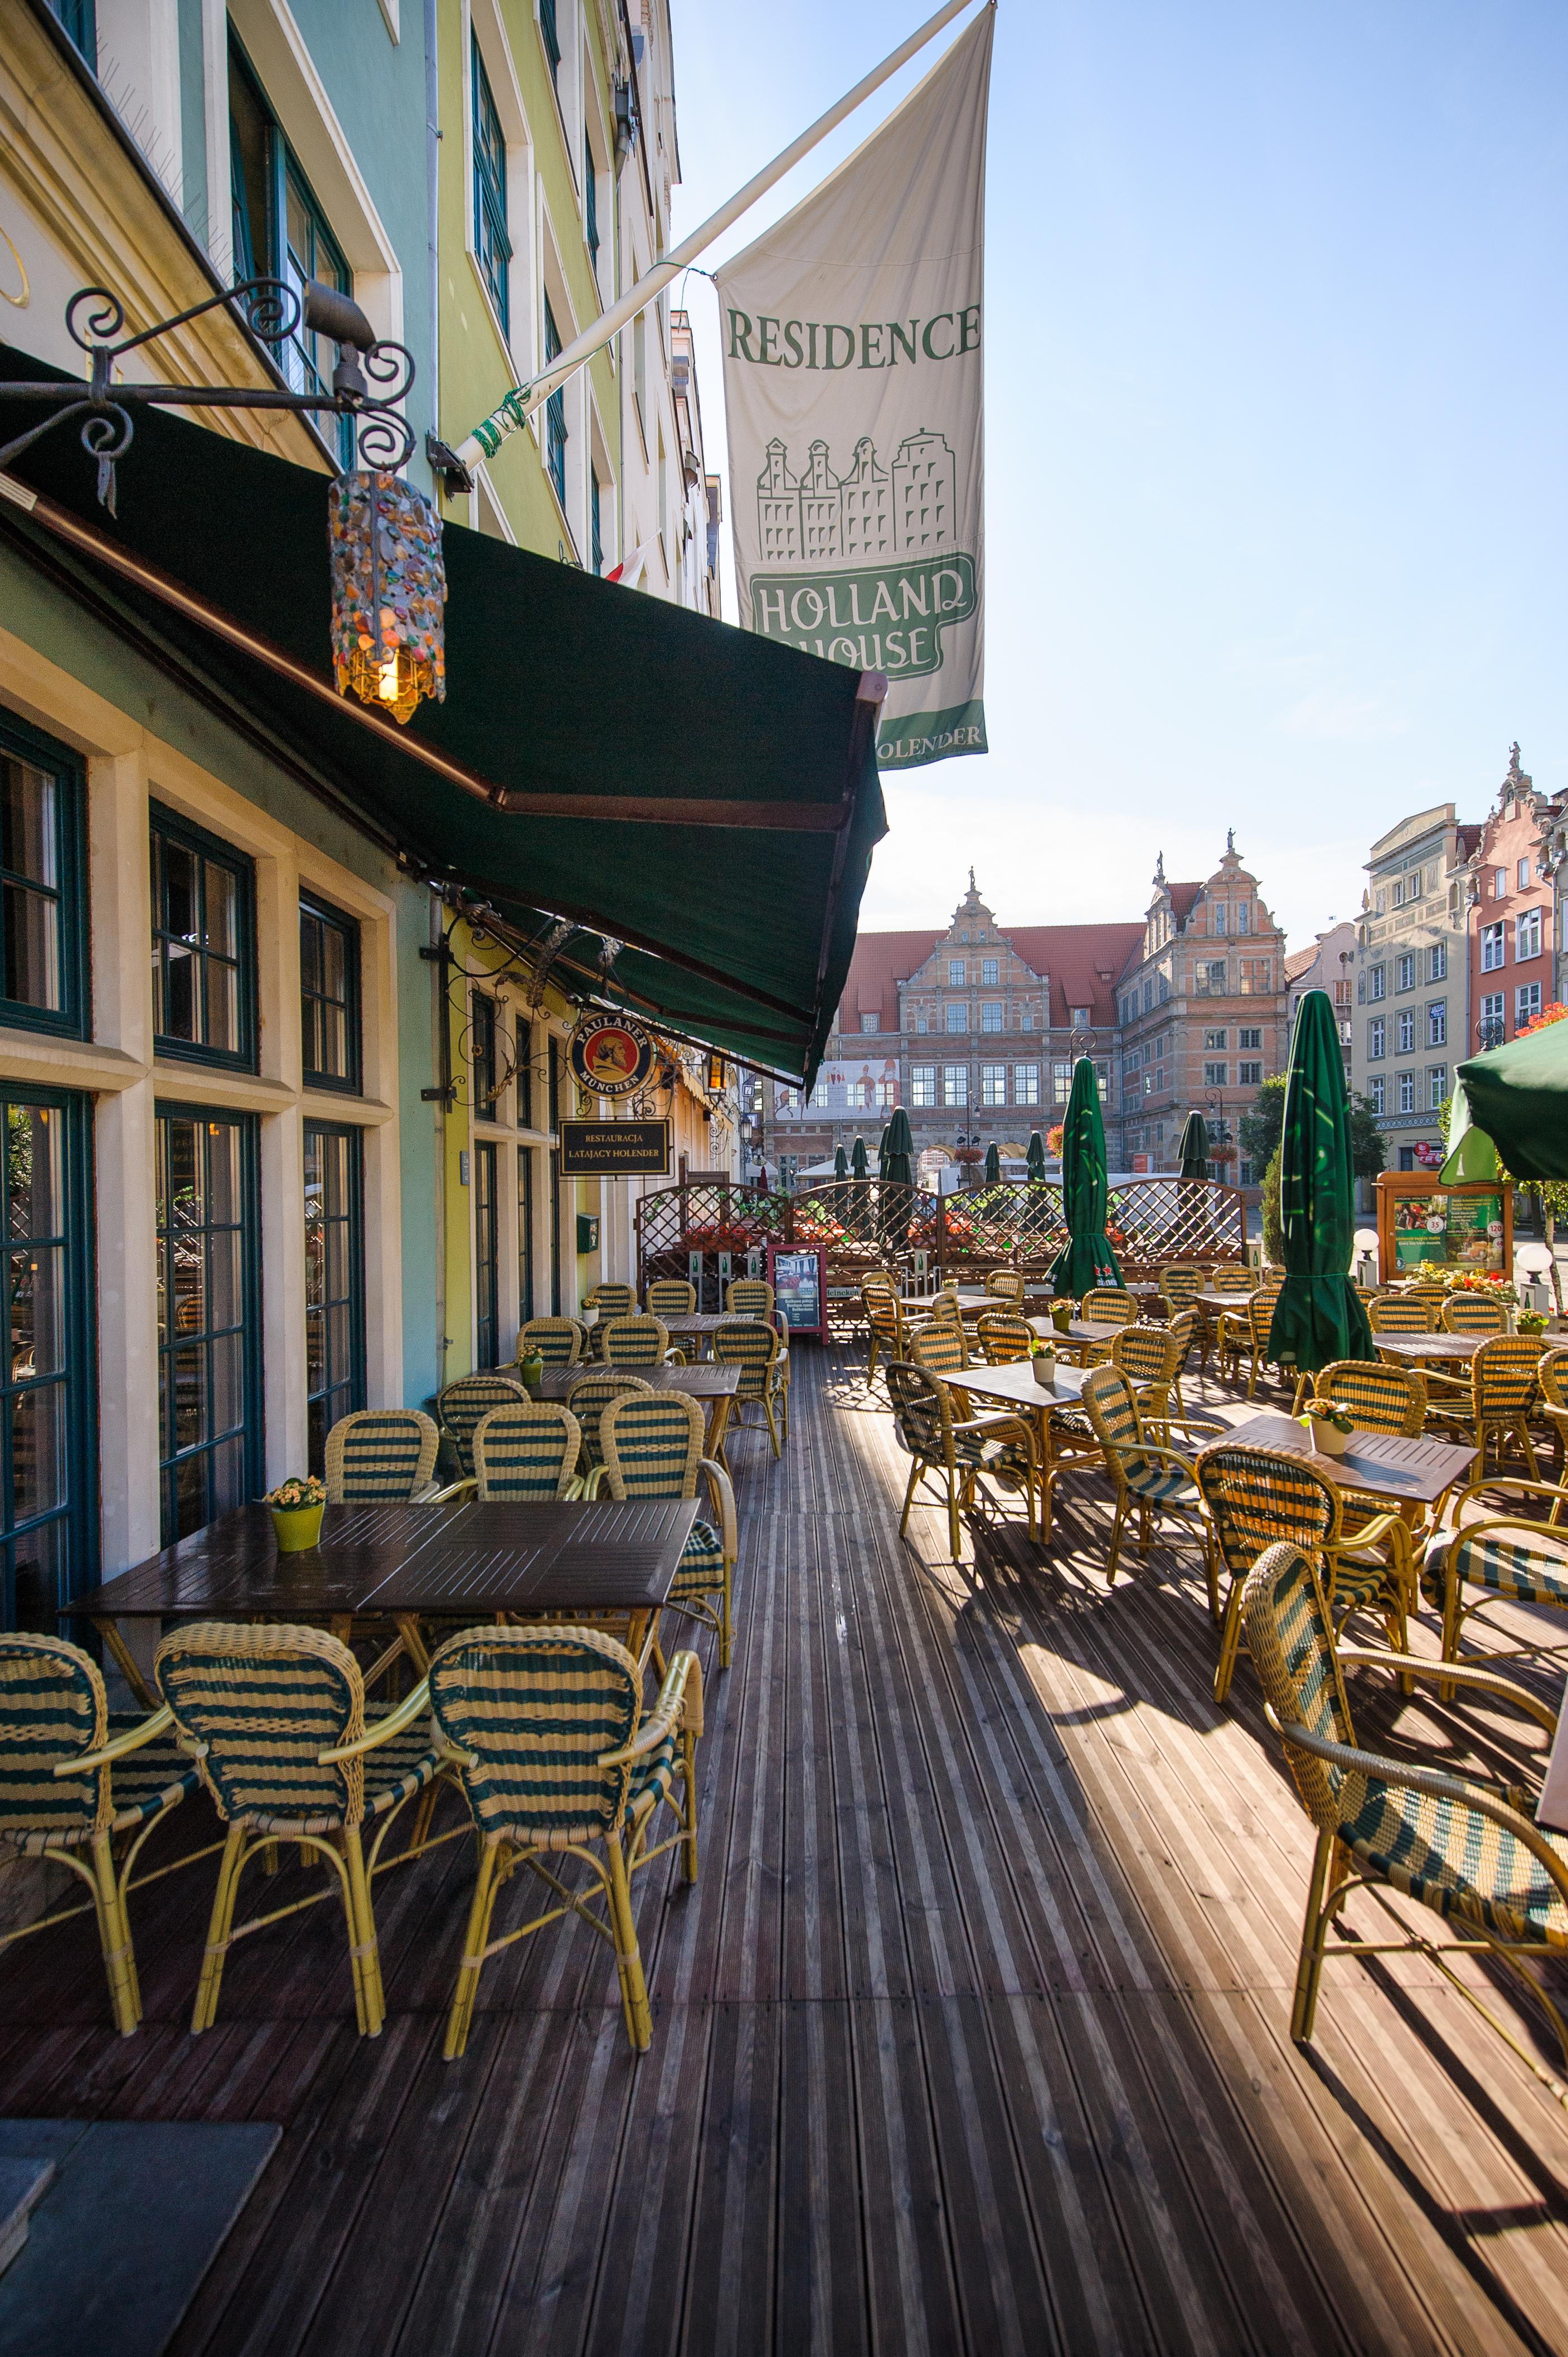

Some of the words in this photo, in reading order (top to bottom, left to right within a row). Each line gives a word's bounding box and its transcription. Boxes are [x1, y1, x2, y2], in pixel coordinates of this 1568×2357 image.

[727, 303, 981, 370] RESIDENCE
[759, 569, 968, 633] HOLLAND
[877, 726, 983, 759] OLENDER
[576, 1017, 647, 1048] PAULANER
[585, 1134, 643, 1143] RESTAURACJA
[613, 1149, 659, 1157] HOLENDER
